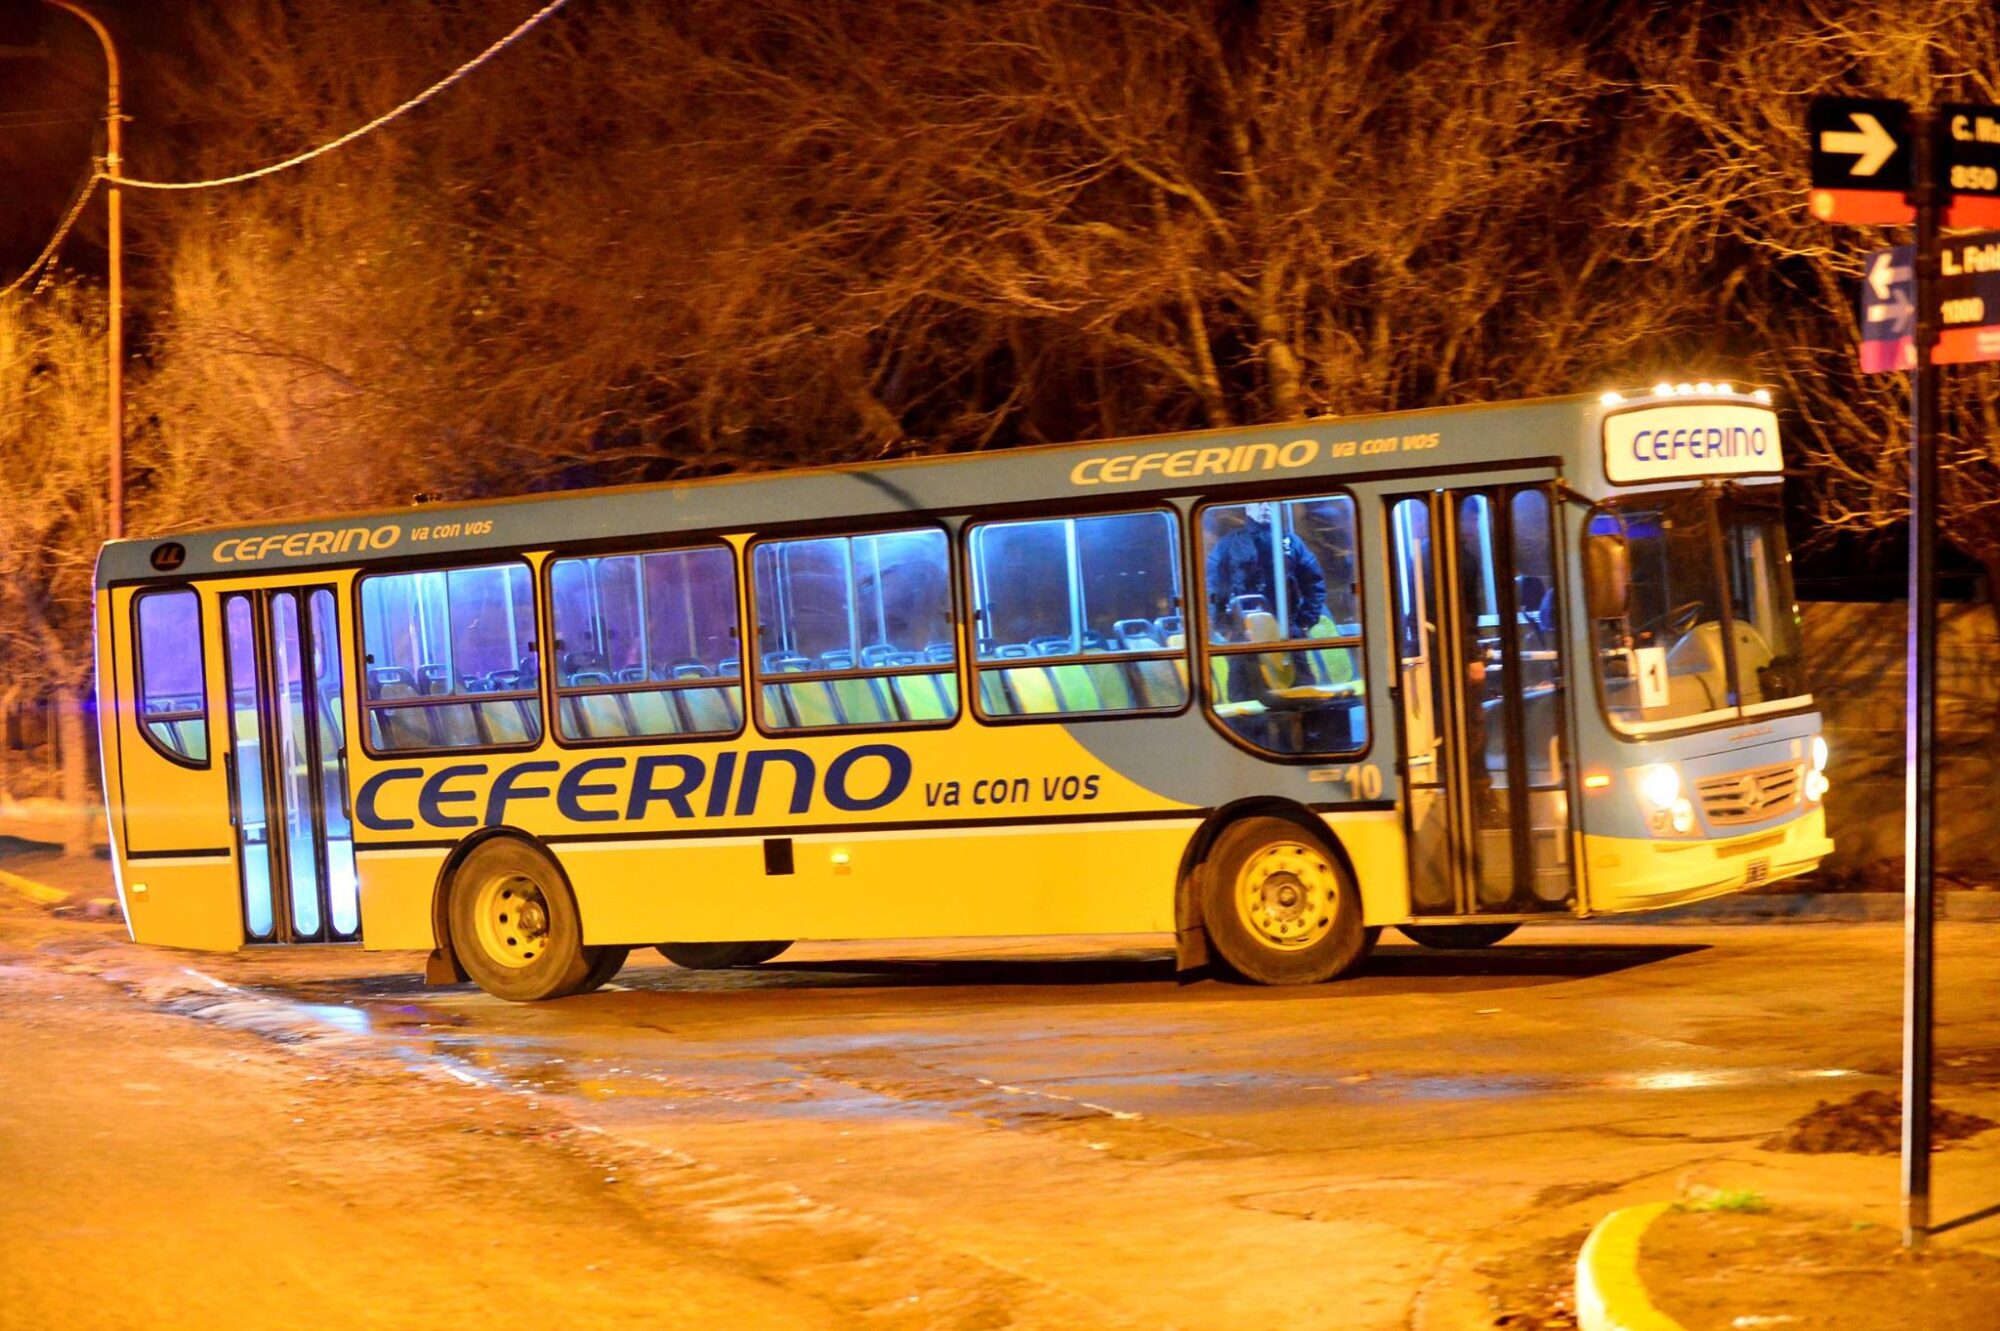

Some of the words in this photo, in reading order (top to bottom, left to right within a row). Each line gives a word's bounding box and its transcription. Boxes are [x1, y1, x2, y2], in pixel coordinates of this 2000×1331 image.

[1069, 439, 1320, 486] CEFERINO
[1331, 440, 1356, 458] va
[1360, 436, 1398, 455] con
[1402, 432, 1440, 451] vos
[1632, 426, 1767, 462] CEFERINO
[212, 524, 402, 564] CEFERINO
[411, 526, 429, 541] va
[432, 523, 460, 538] con
[464, 520, 494, 535] vos
[355, 744, 912, 831] CEFERINO
[925, 781, 961, 807] va
[972, 777, 1030, 805] con
[1043, 774, 1101, 802] vos
[1344, 763, 1383, 801] 10
